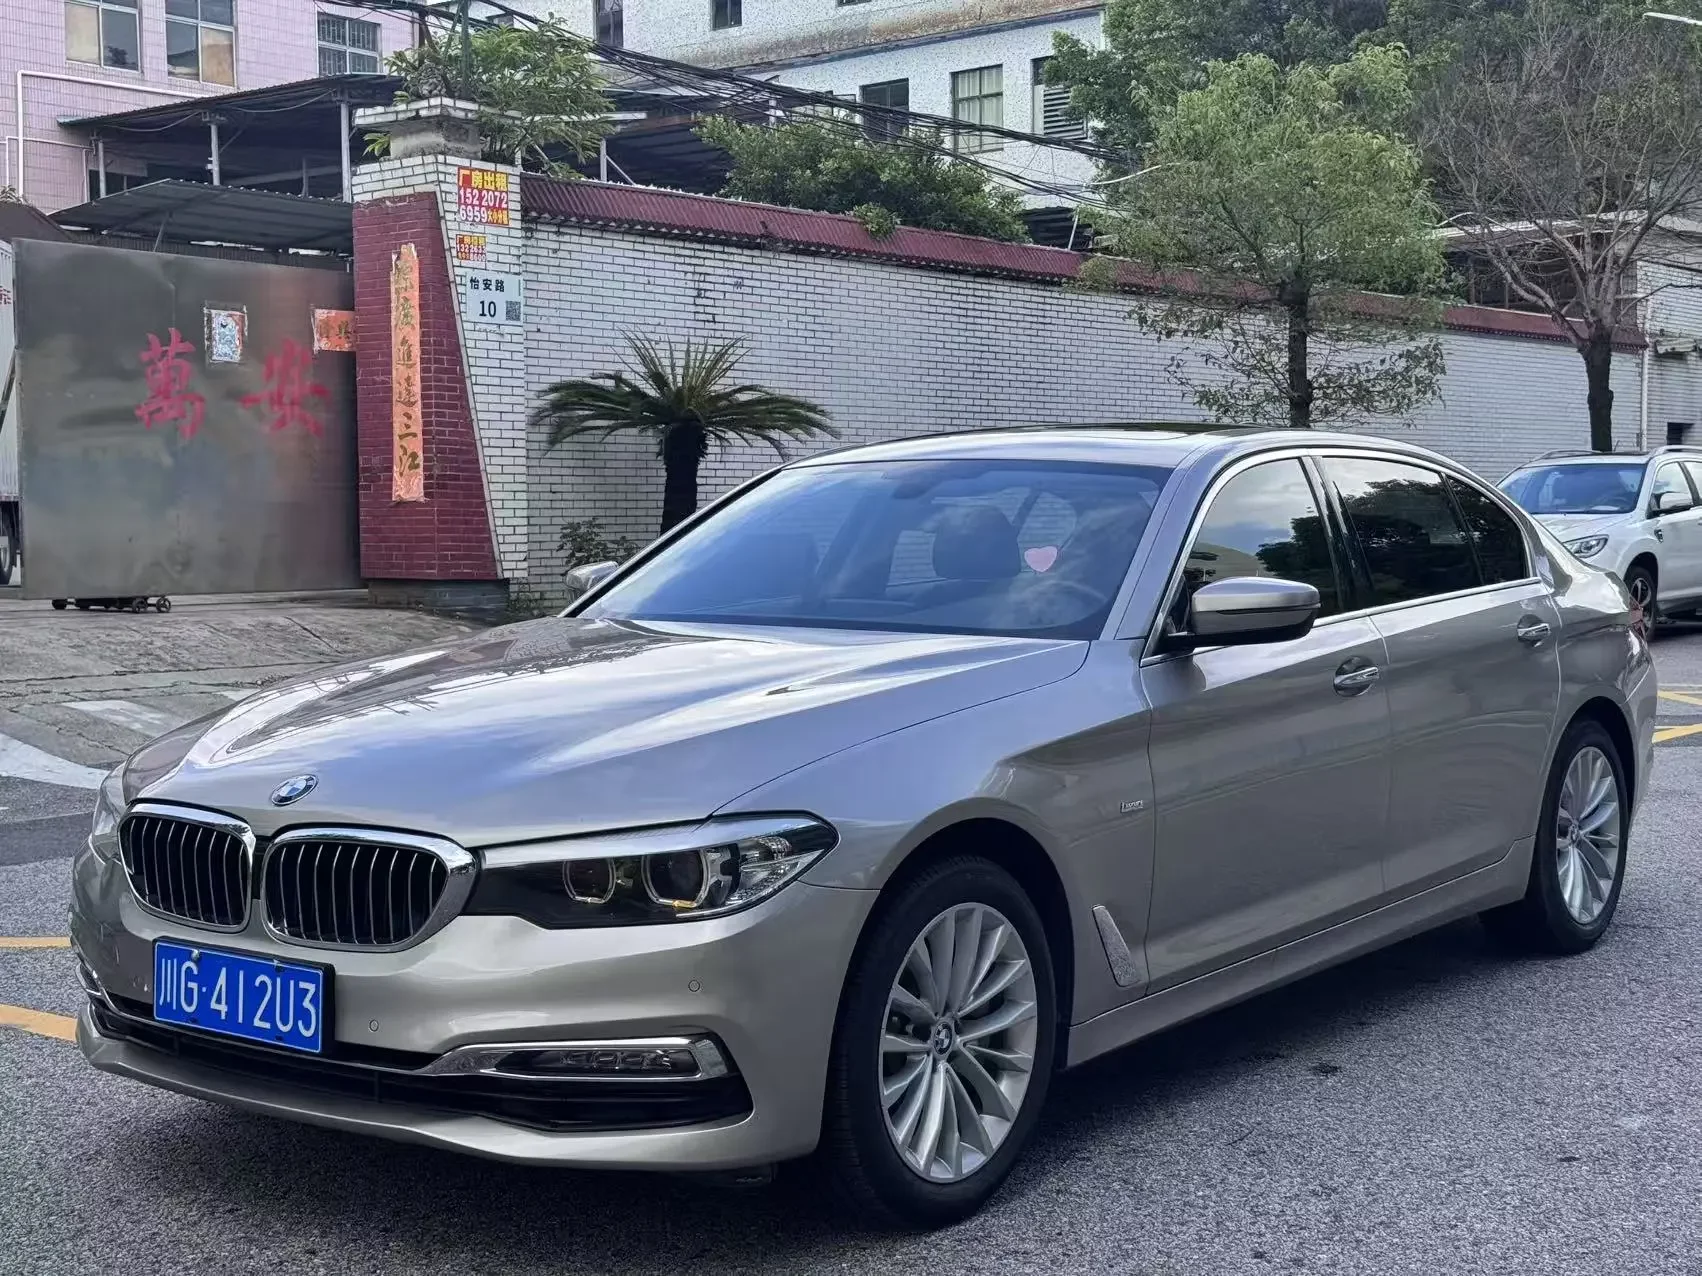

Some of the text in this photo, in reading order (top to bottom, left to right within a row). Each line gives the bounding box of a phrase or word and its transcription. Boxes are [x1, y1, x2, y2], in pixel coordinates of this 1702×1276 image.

[459, 169, 507, 191] 厂房出租
[460, 205, 487, 223] 6959
[469, 276, 505, 293] 怡安路
[479, 301, 497, 318] 10
